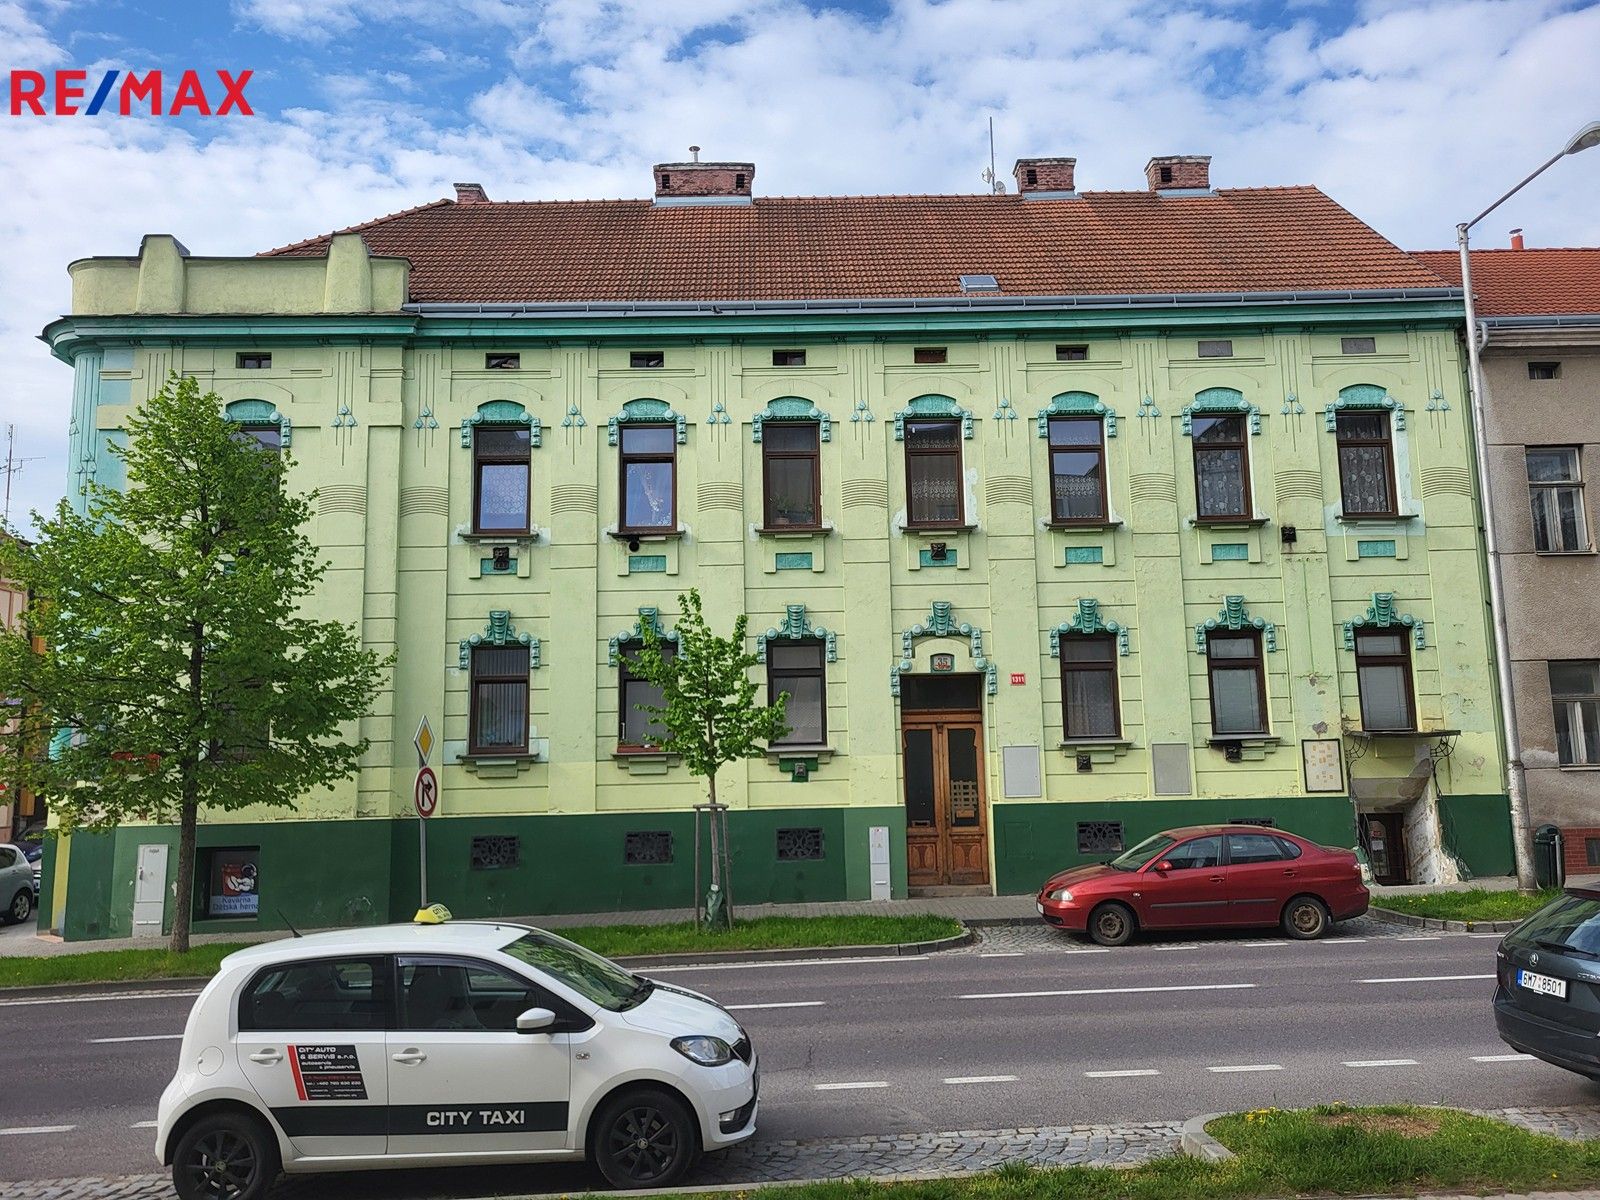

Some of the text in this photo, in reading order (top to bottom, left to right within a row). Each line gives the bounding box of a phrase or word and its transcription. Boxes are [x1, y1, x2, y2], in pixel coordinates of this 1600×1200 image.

[1523, 973, 1562, 995] 6M7 8501
[426, 1110, 525, 1126] CITY TAXI
